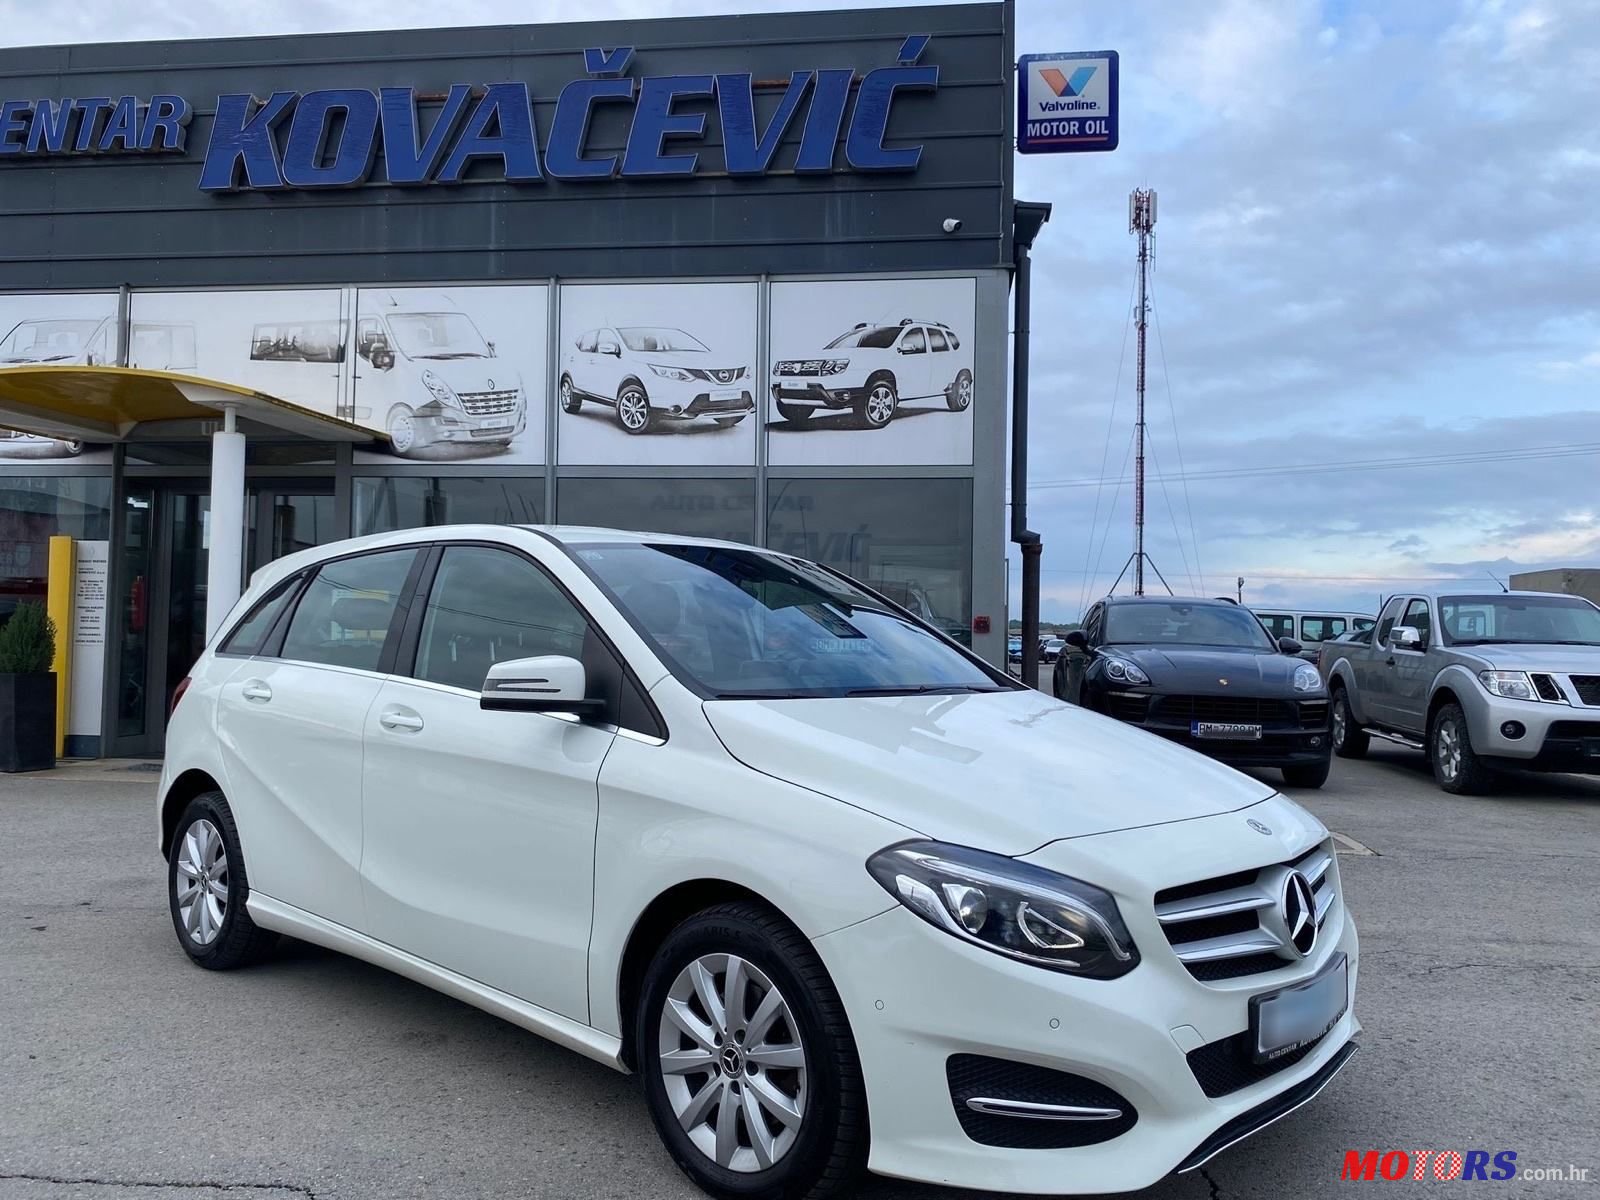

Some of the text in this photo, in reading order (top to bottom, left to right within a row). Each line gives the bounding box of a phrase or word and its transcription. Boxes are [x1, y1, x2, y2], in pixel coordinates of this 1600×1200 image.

[199, 33, 940, 193] KOVAČEVIĆ
[1039, 100, 1097, 112] Valvoline
[1027, 120, 1109, 137] MOTOR OIL
